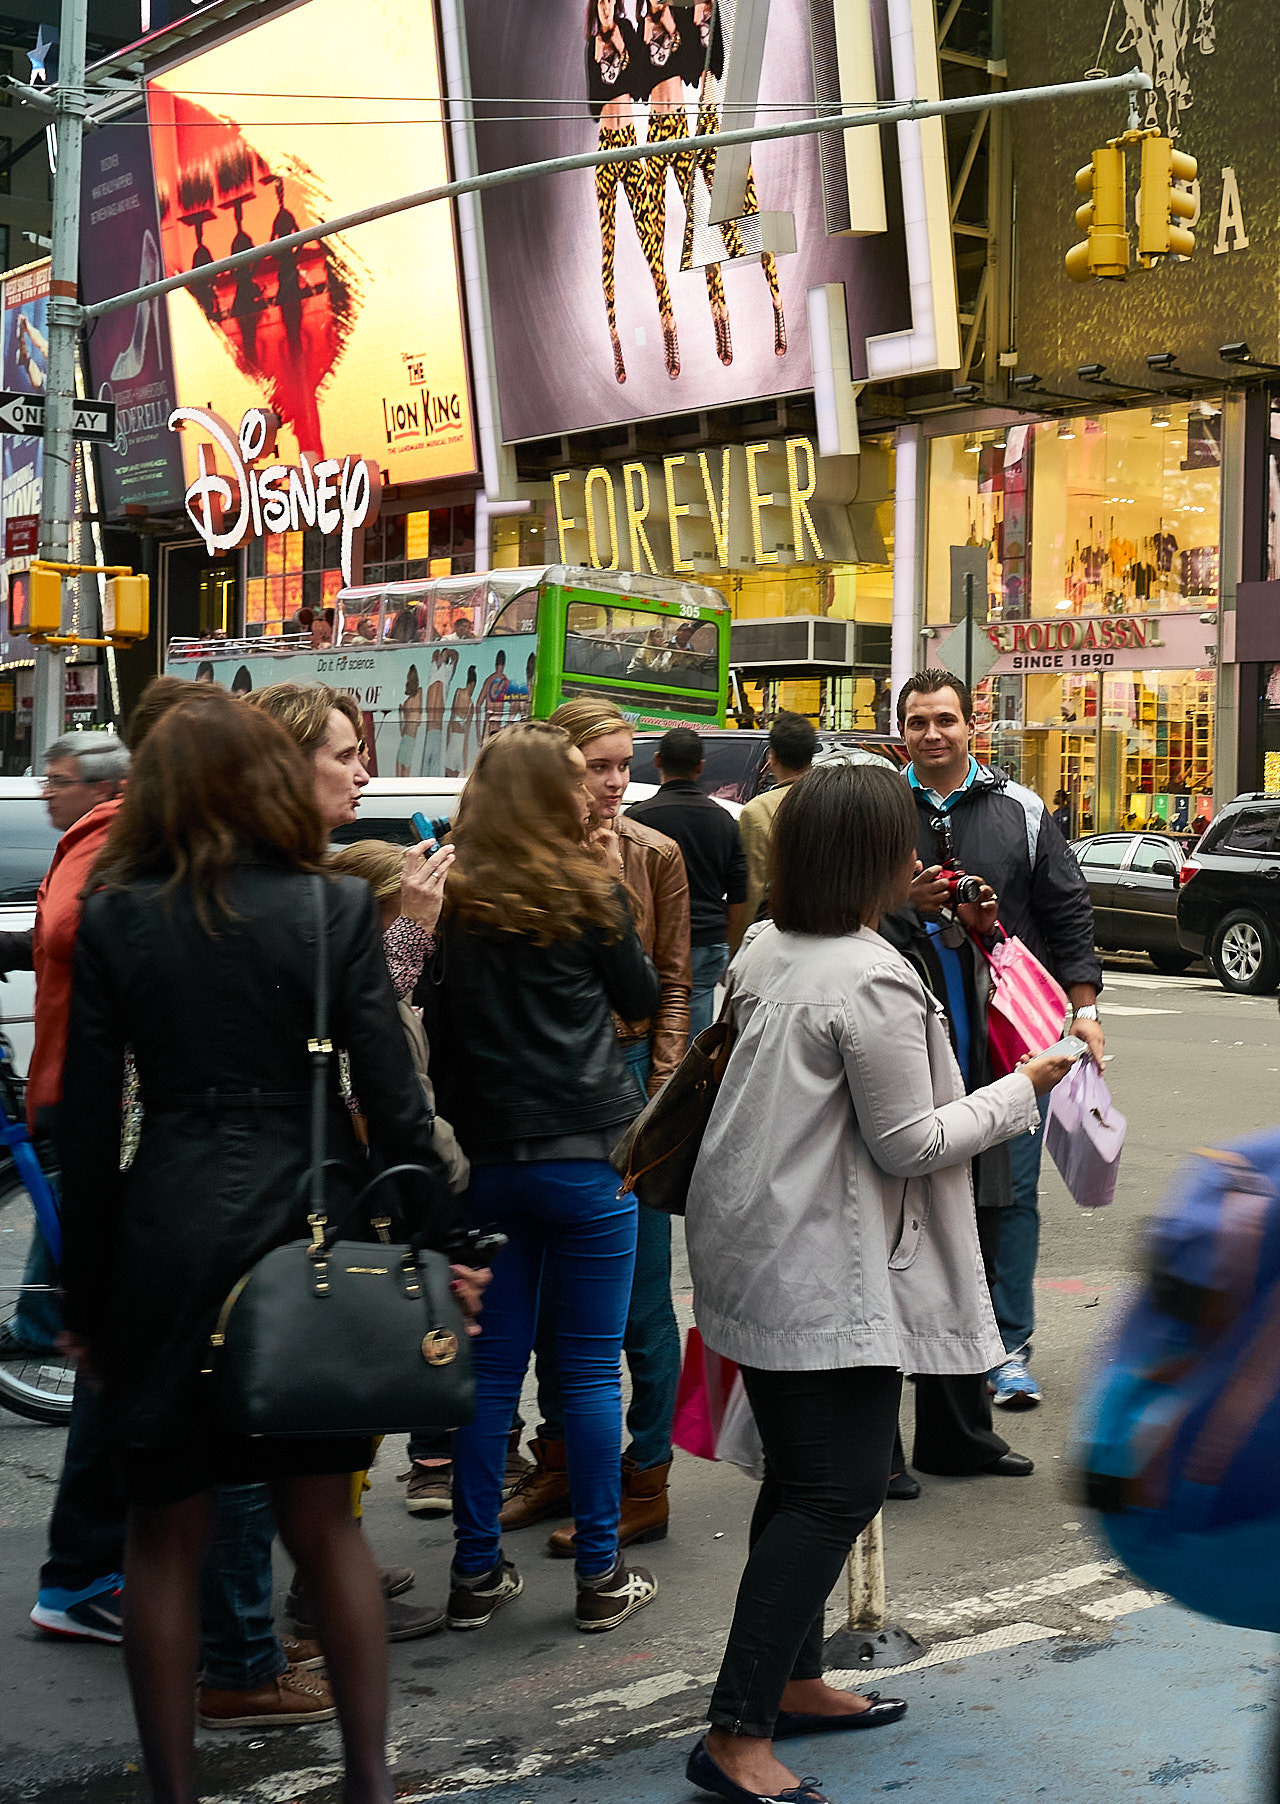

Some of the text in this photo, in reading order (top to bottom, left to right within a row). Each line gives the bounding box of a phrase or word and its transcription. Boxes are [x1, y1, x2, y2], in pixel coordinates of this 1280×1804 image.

[407, 362, 424, 381] THE
[75, 410, 99, 429] AY
[383, 388, 461, 443] LION KING
[168, 407, 370, 588] Disney
[552, 436, 825, 574] FOREVER
[679, 604, 701, 619] 305
[1013, 621, 1076, 652] POLO
[1013, 653, 1114, 669] SINCE 1890
[366, 686, 382, 704] OF
